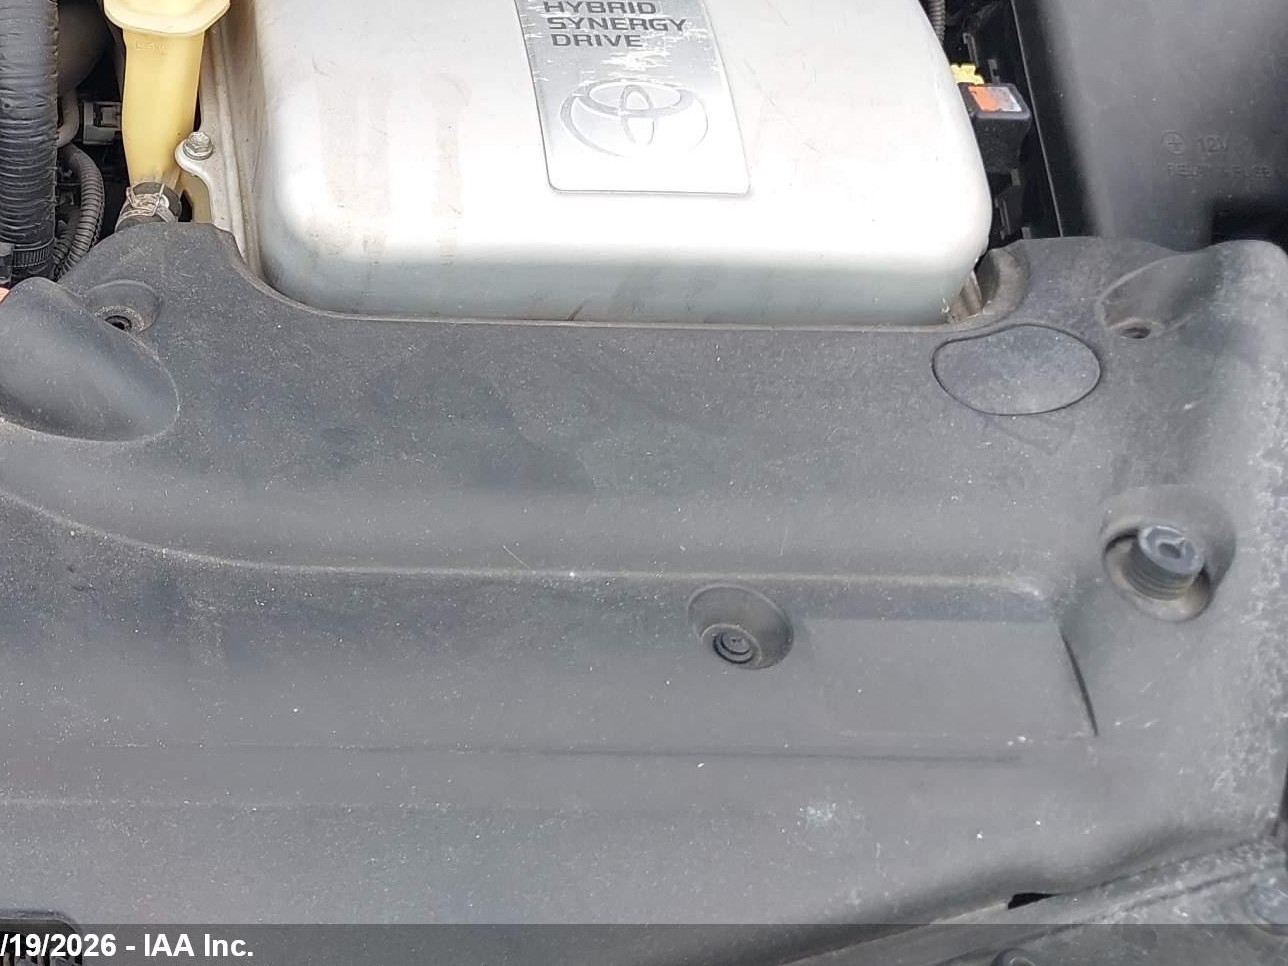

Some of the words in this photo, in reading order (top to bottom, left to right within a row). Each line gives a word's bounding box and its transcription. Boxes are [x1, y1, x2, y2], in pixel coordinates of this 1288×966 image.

[543, 1, 657, 14] HYBRID
[547, 17, 687, 31] SYNERGY
[551, 34, 643, 47] DRIVE
